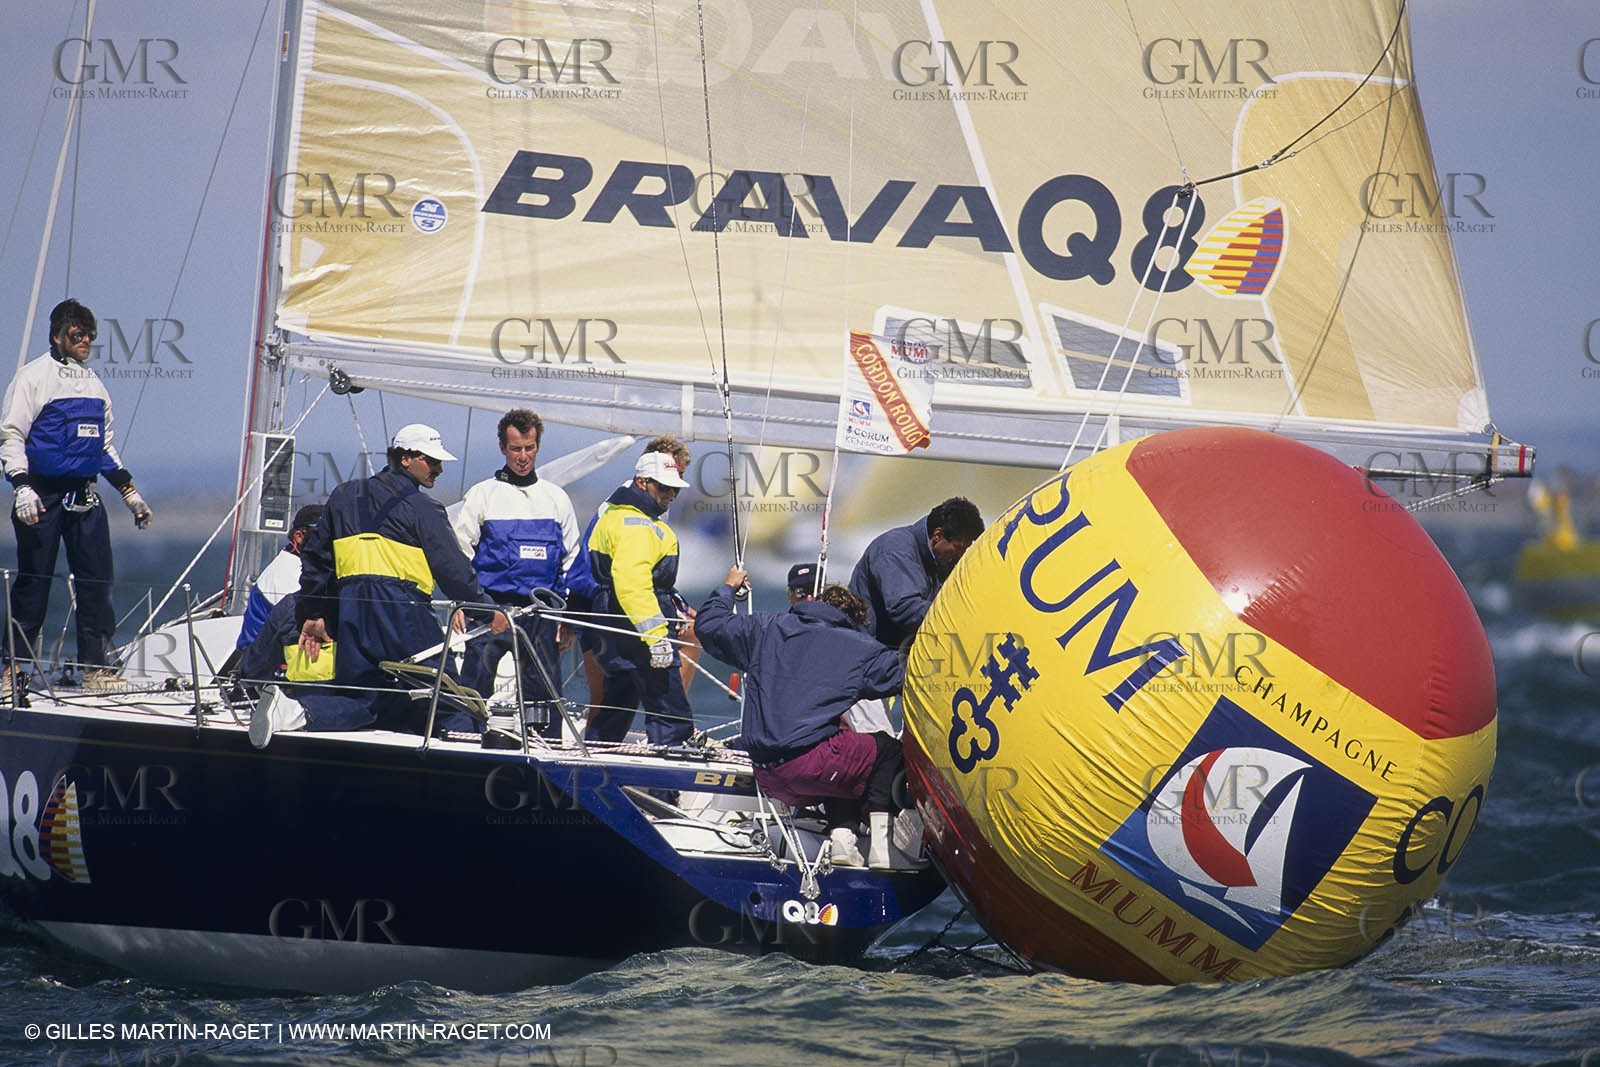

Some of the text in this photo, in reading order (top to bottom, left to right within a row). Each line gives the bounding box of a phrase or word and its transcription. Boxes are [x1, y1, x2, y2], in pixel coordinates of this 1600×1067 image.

[855, 343, 900, 404] CORDON
[854, 428, 889, 442] CORUM
[1234, 665, 1398, 782] CHAMPAGNE
[782, 900, 821, 924] Q8
[1070, 859, 1242, 980] MUMM
